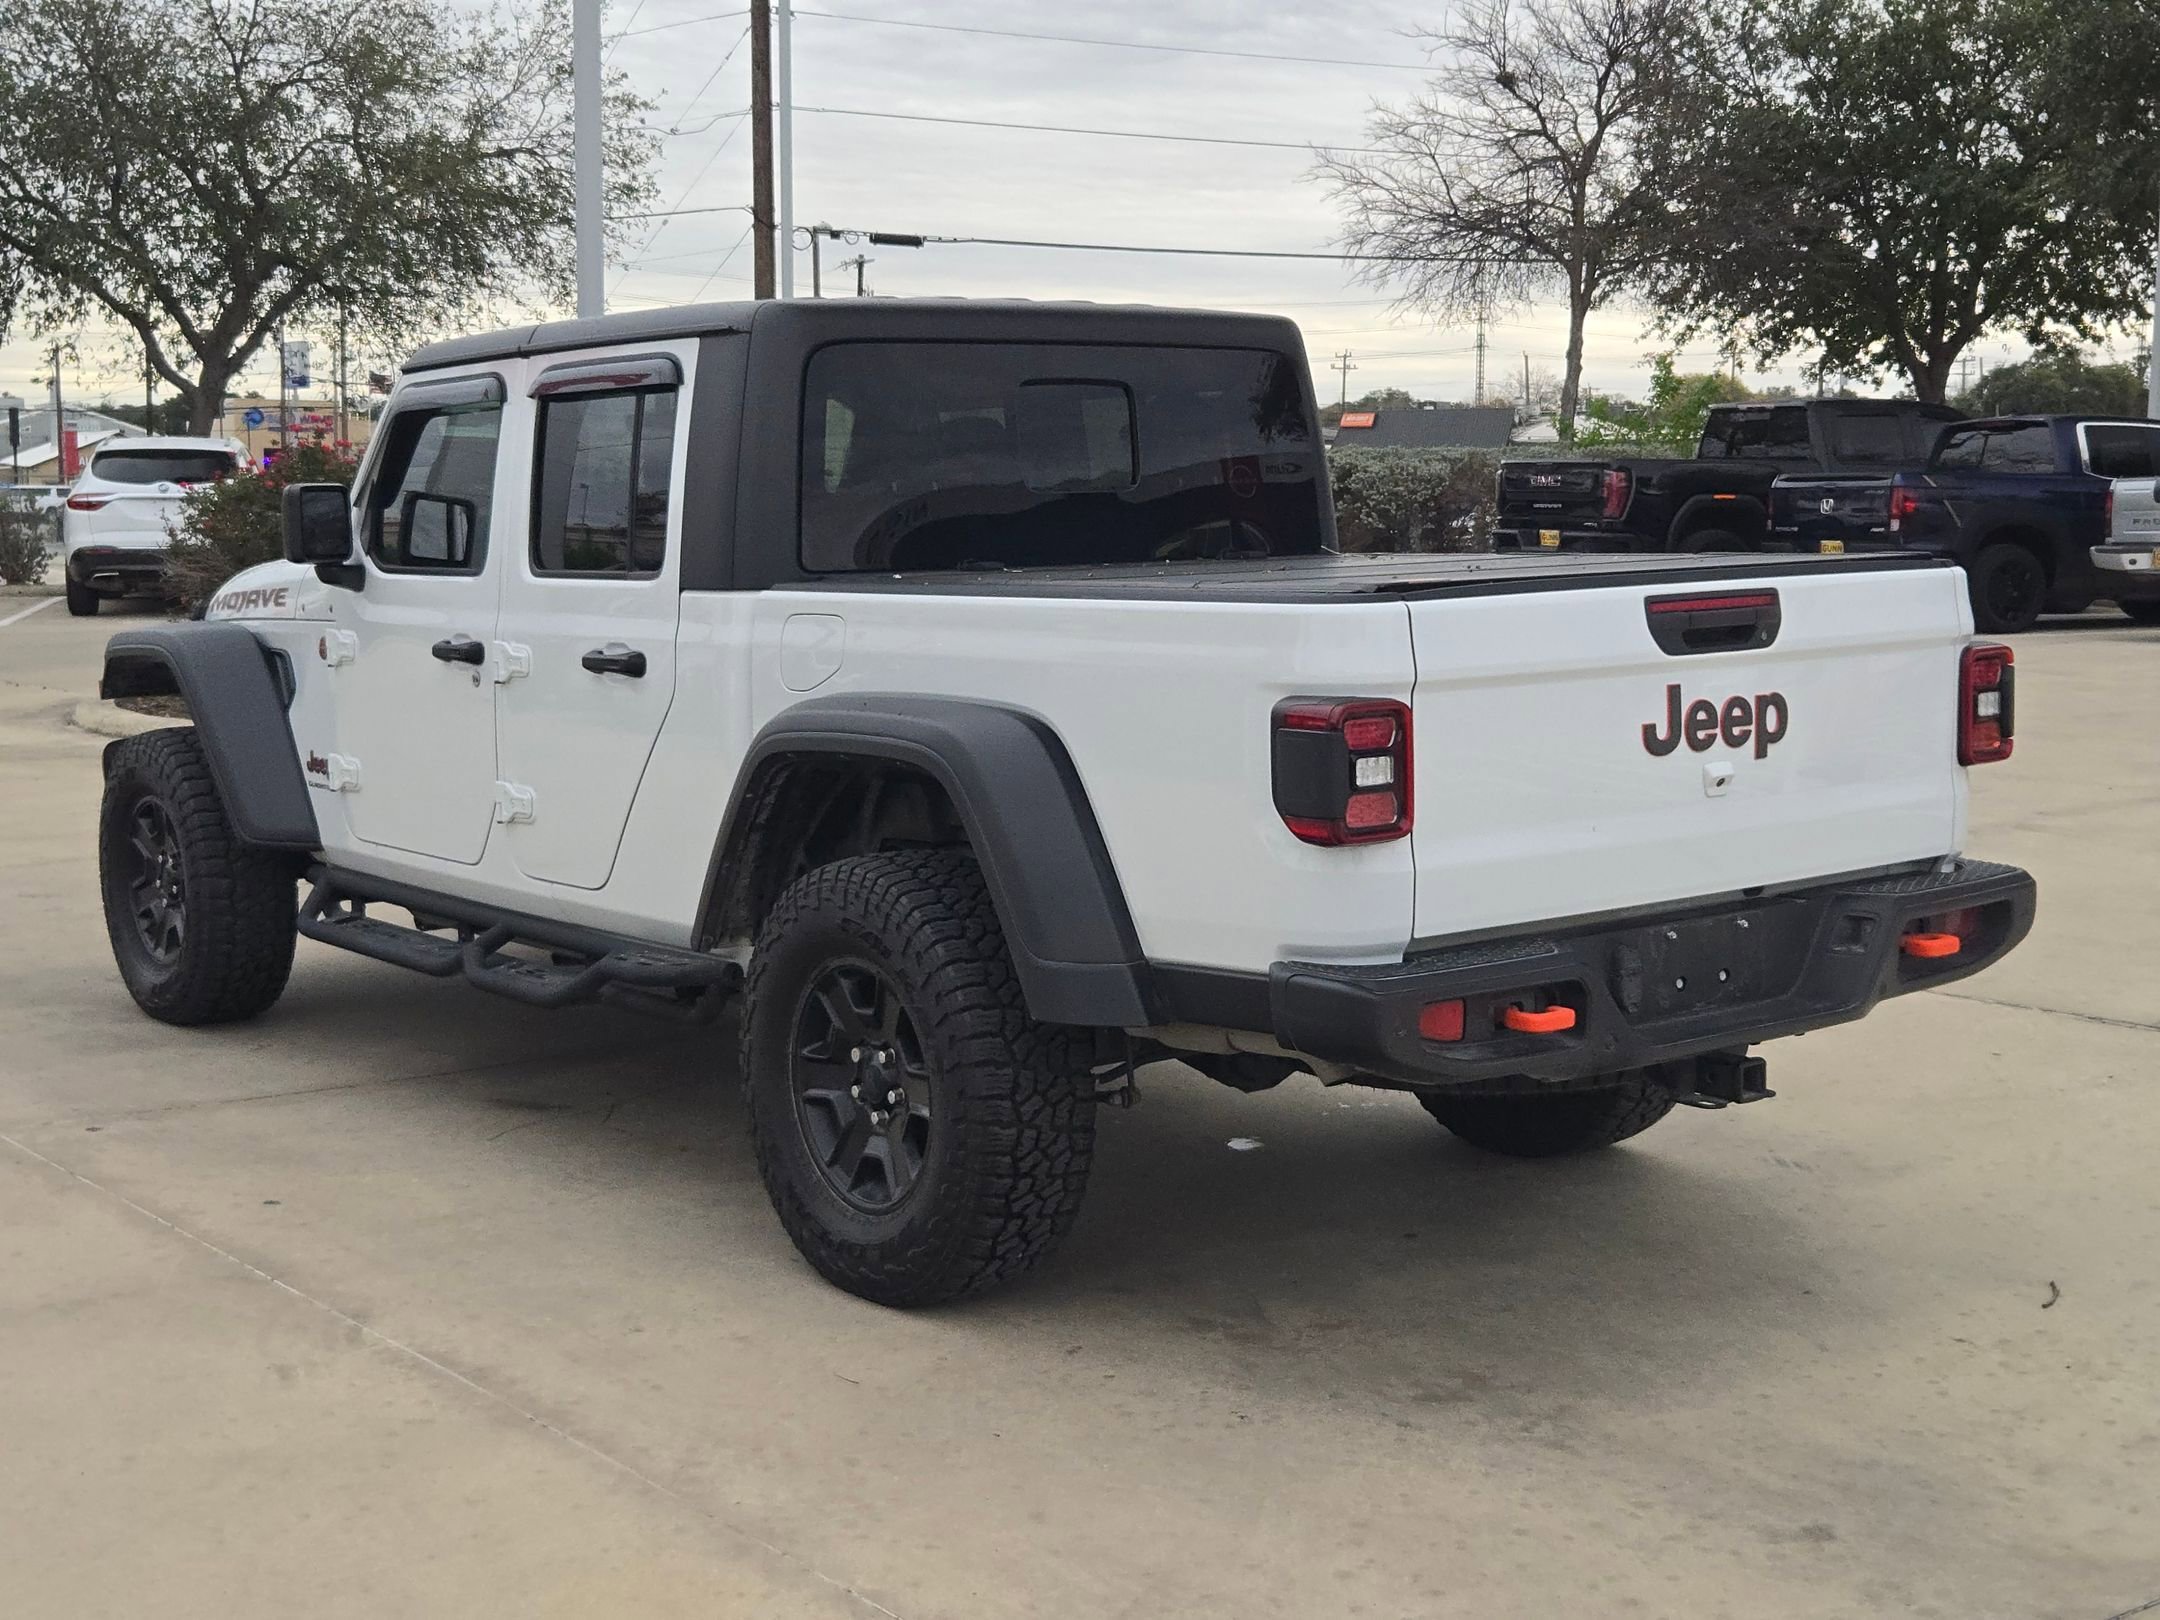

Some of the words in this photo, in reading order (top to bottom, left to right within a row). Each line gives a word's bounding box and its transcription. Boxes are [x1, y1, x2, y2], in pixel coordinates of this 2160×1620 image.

[1821, 543, 1843, 553] GUNN
[210, 587, 289, 613] MOJAVE
[1641, 683, 1788, 760] Jeep
